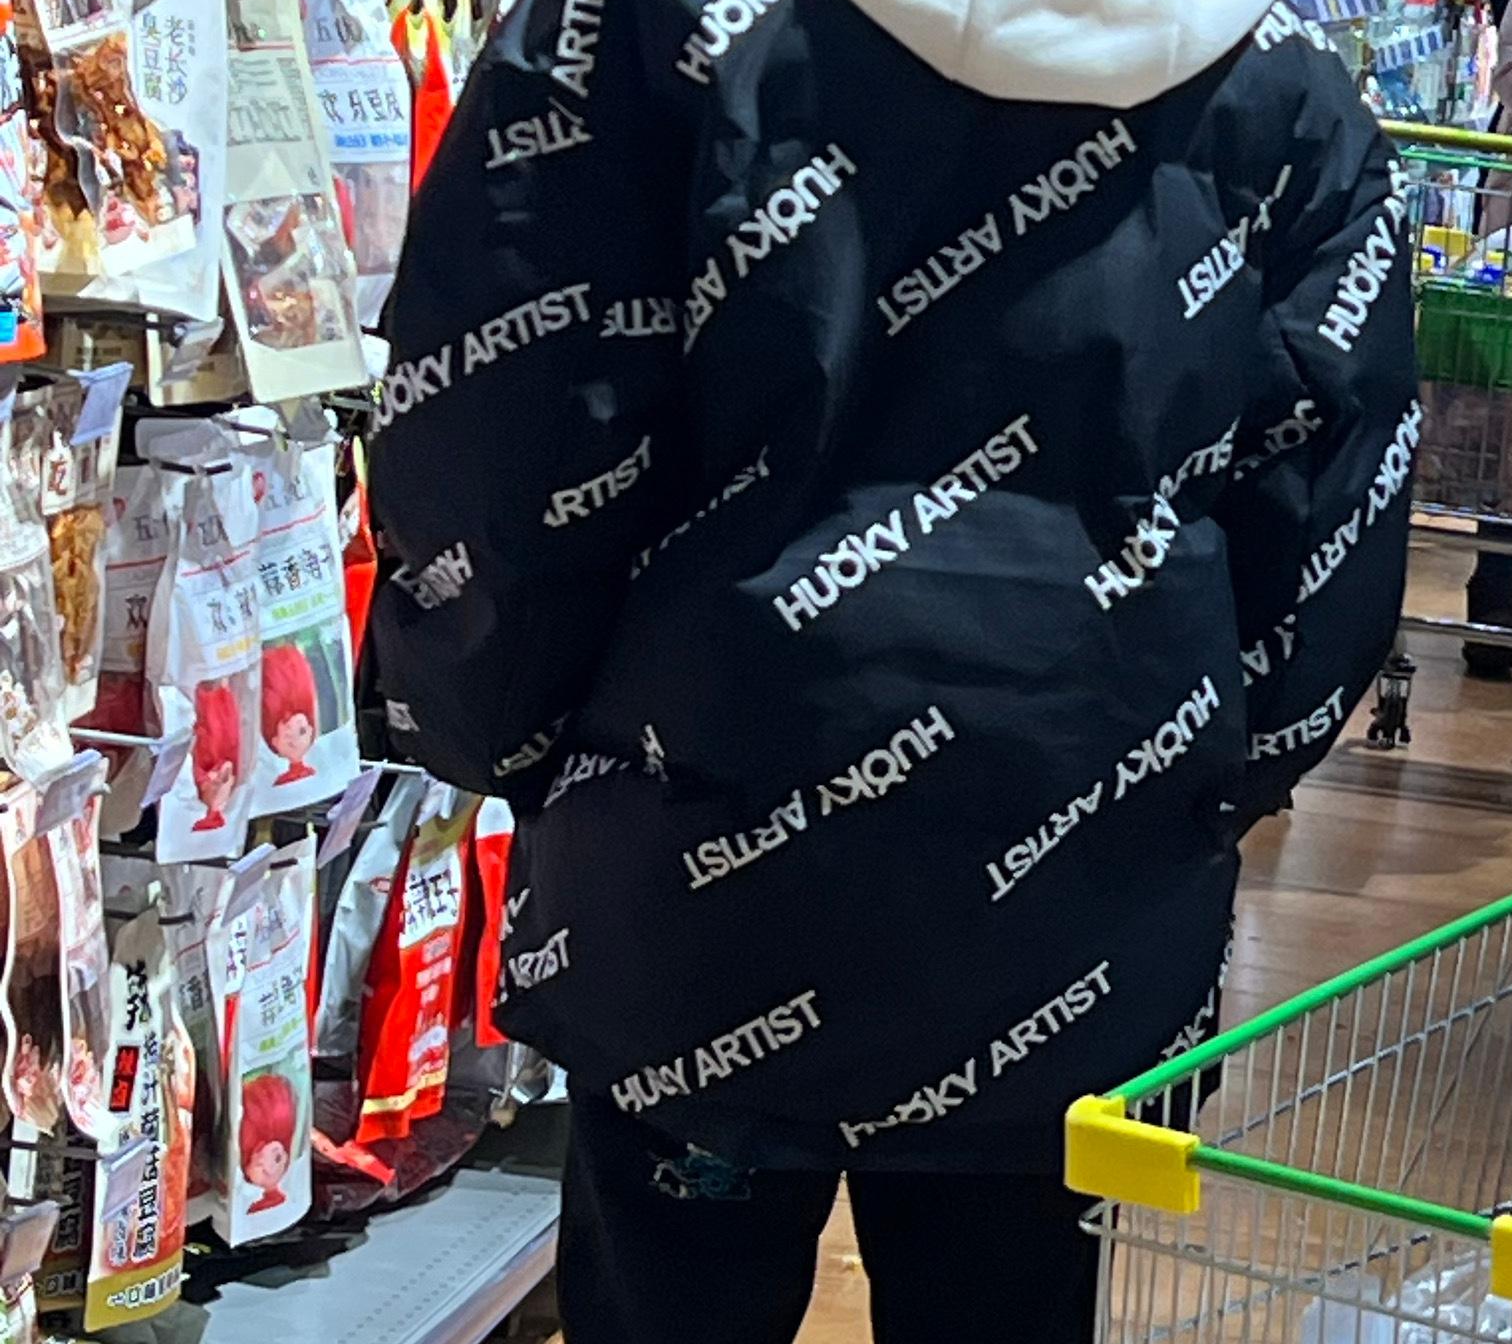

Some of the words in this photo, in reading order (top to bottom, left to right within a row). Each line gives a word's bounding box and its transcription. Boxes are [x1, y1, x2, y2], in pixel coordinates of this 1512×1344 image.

[463, 282, 592, 375] ARTIST
[876, 213, 1003, 337] ARTIST
[912, 413, 1039, 534] ARTIST
[1248, 685, 1345, 760] RTIST
[682, 788, 809, 891] ARTIST
[985, 781, 1103, 902] ARTIST
[691, 989, 825, 1088] ARTIST
[988, 959, 1113, 1077] ARTIST
